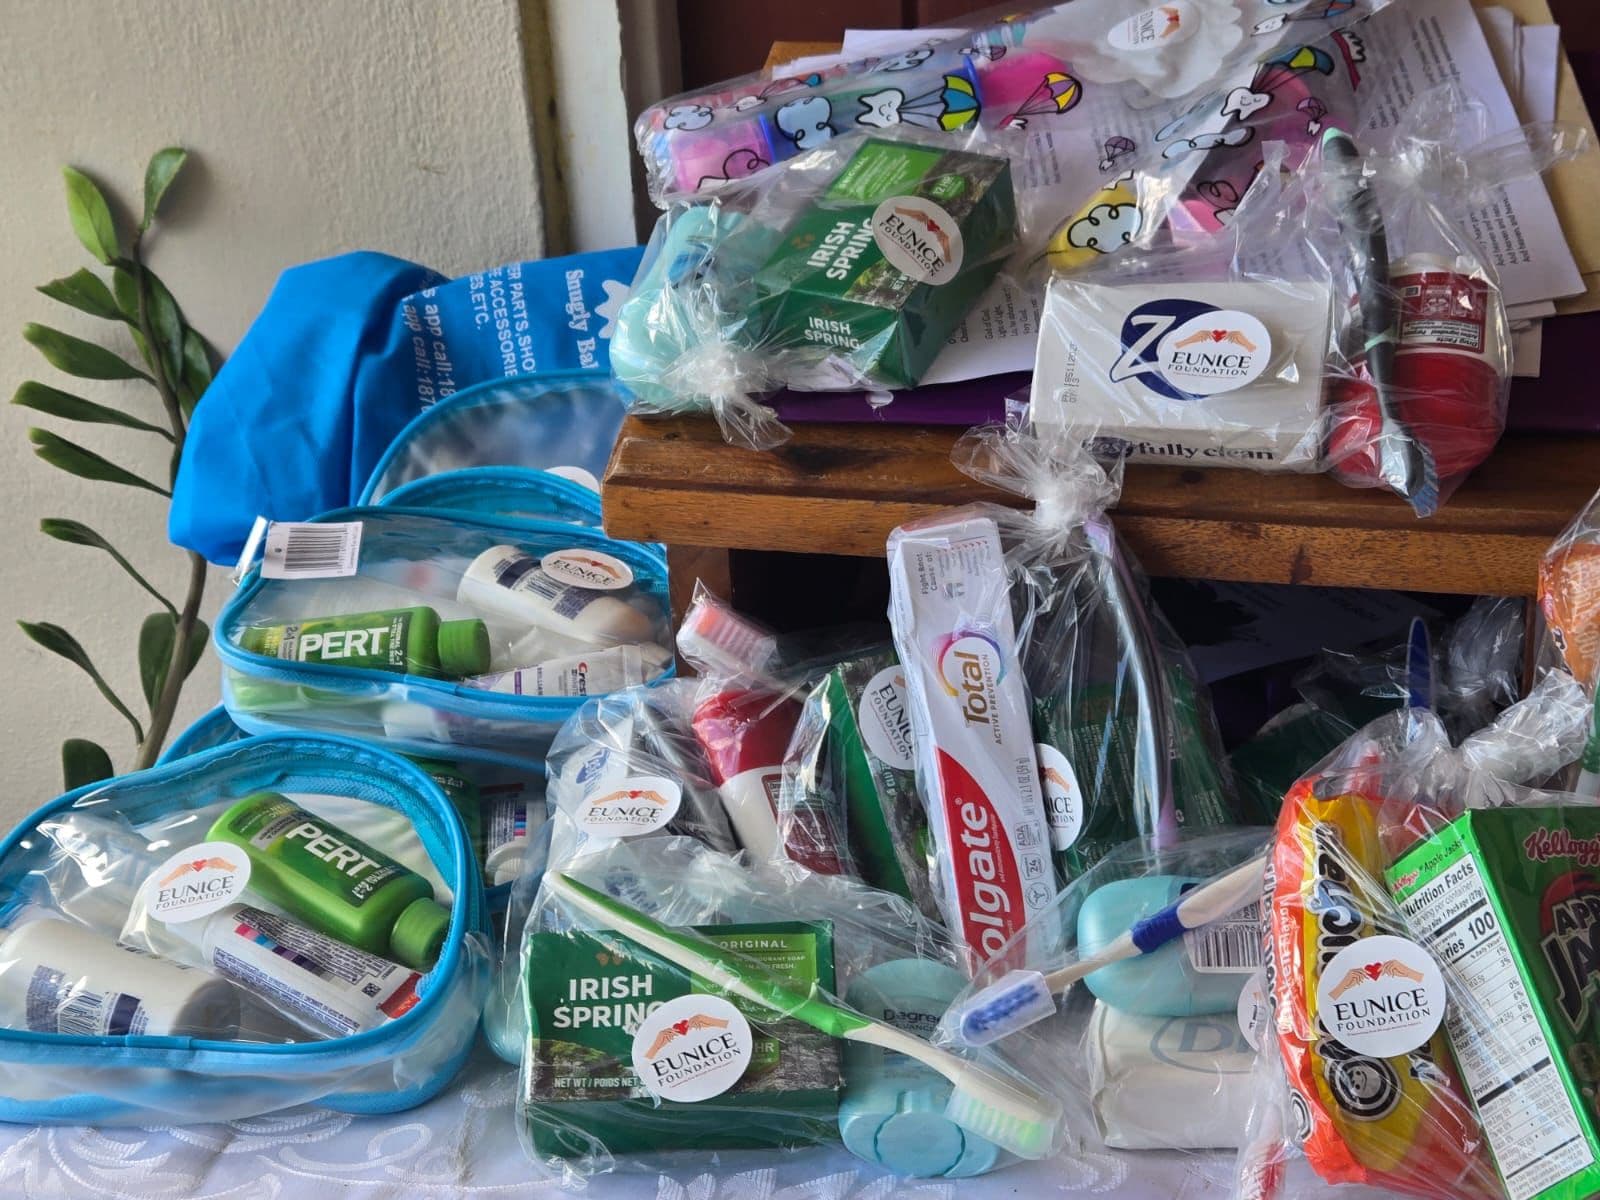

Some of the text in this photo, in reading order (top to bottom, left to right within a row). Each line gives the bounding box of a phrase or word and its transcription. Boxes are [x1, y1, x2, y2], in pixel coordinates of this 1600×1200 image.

[807, 221, 855, 268] IRISH
[879, 221, 936, 277] FOUNDATION
[885, 213, 945, 272] EUNICE
[403, 306, 422, 333] app
[424, 304, 443, 337] app
[509, 282, 537, 374] PARTS,SHO
[809, 316, 851, 334] IRISH
[804, 329, 862, 350] SPRING
[1168, 364, 1248, 377] FOUNDATION
[1171, 352, 1252, 369] EUNICE
[1203, 445, 1275, 461] clean
[553, 560, 615, 585] EUNICE
[918, 551, 930, 596] Fight Root
[300, 627, 389, 661] PERT
[954, 651, 990, 725] Total
[984, 654, 1002, 745] ACTIVE PREVENTION
[871, 690, 913, 761] FOUNDATION
[588, 807, 662, 818] EUNICE
[1049, 797, 1073, 814] ICE
[1051, 815, 1075, 824] ATION
[287, 822, 380, 877] PERT
[1525, 827, 1600, 867] Kellogg'
[1423, 854, 1444, 873] Apple
[1445, 862, 1475, 889] Facts
[158, 875, 235, 902] EUNICE
[960, 802, 1012, 963] olgate
[155, 888, 233, 911] FOUNDATION
[1446, 899, 1468, 920] Package
[1553, 896, 1600, 937] APP
[719, 939, 788, 949] ORIGINAL
[1440, 911, 1495, 961] ories 100
[569, 975, 652, 1001] IRISH
[1334, 988, 1429, 1021] EUNICE
[1337, 1008, 1431, 1032] FOUNDATION
[651, 1033, 737, 1077] EUNICE
[657, 1047, 742, 1088] FOUNDATION
[554, 1077, 570, 1088] NET
[573, 1077, 587, 1087] WT
[593, 1077, 620, 1087] POIDS
[621, 1076, 638, 1087] NET
[1473, 1079, 1494, 1097] Protein
